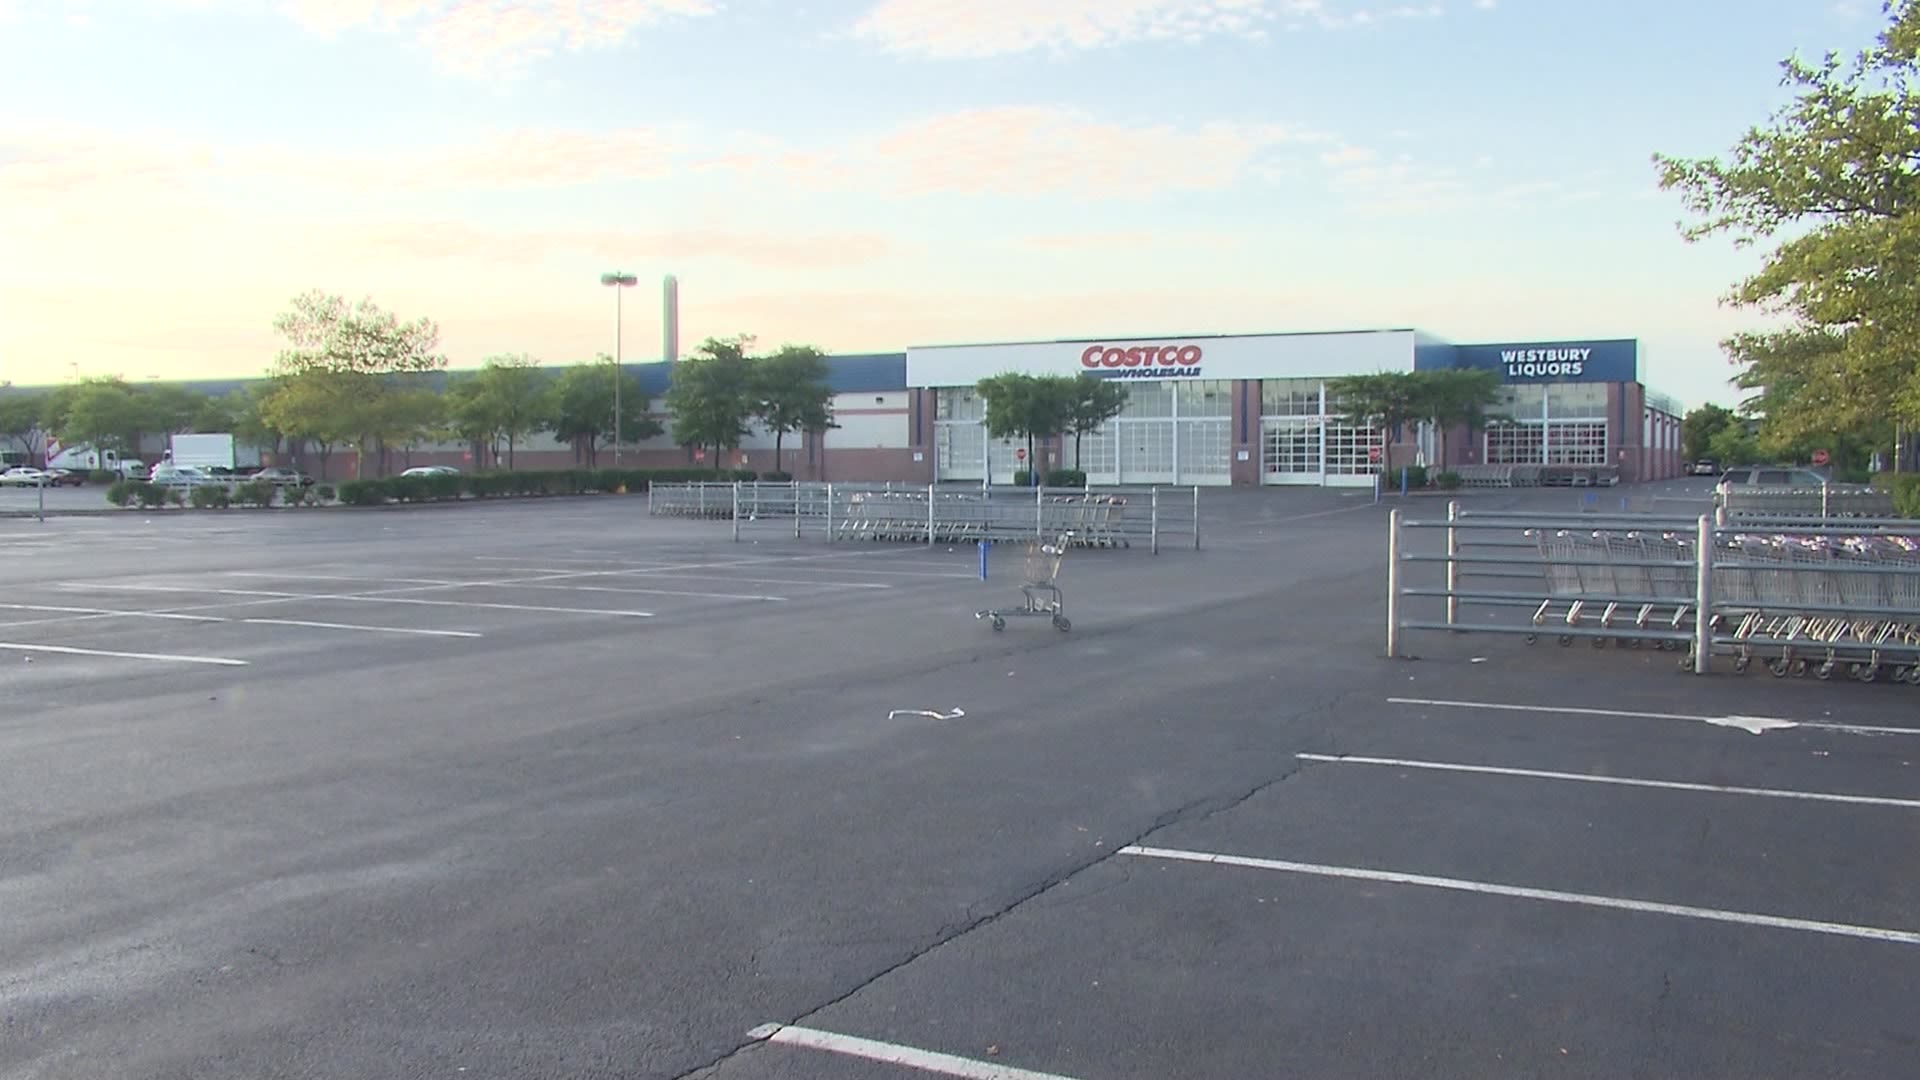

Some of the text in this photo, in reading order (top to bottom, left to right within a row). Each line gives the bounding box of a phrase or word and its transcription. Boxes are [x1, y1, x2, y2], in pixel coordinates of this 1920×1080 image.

[1081, 345, 1202, 368] COSTCO
[1501, 348, 1591, 363] WESTBURY
[1118, 367, 1201, 378] WHOLESALE
[1508, 362, 1583, 377] LIQUORS
